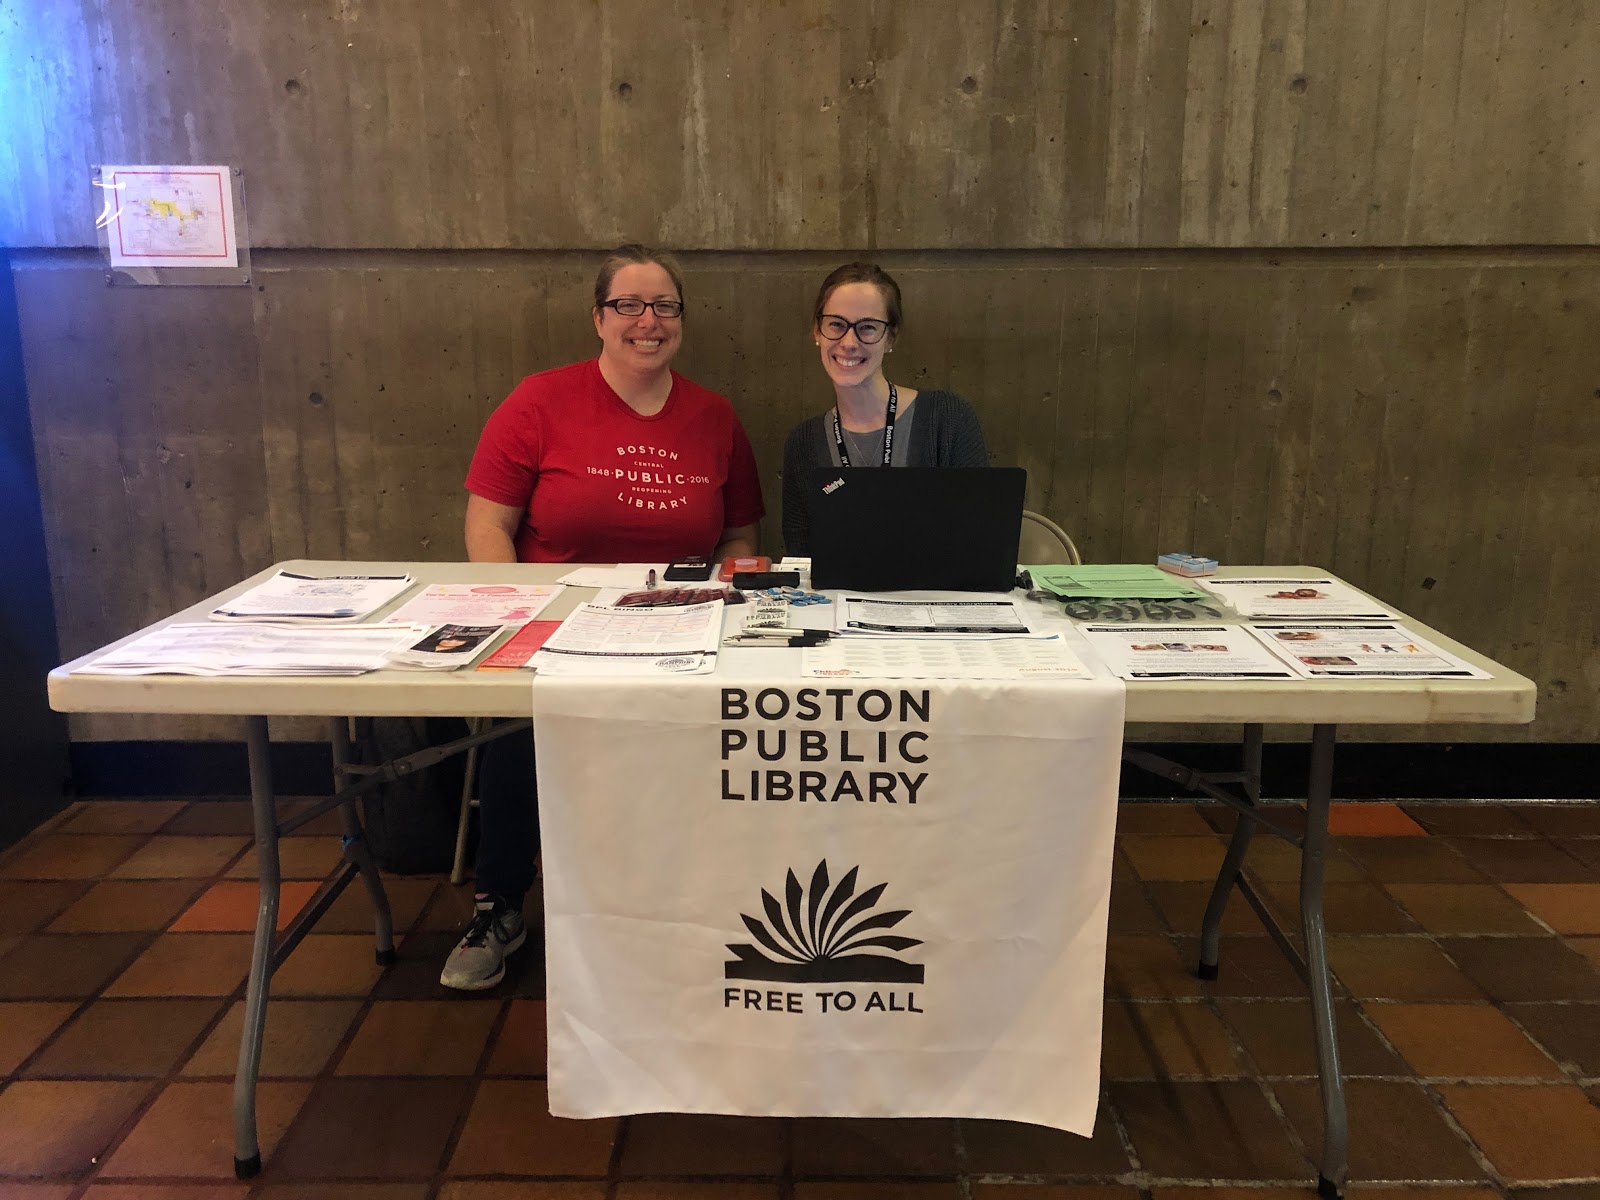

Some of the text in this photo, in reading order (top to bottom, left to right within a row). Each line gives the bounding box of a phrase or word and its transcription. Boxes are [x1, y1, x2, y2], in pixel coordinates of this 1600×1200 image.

[834, 422, 843, 444] Boston
[886, 425, 894, 448] Boston
[616, 445, 679, 461] BOSTON
[633, 460, 665, 468] CENTRAL
[614, 468, 686, 485] PUBLIC
[617, 492, 688, 510] LIBRARY
[631, 486, 672, 494] REOPENING
[721, 687, 930, 722] BOSTON
[721, 729, 929, 763] PUBLIC
[721, 769, 929, 804] LIBRARY
[724, 988, 924, 1014] FREE TO ALL
